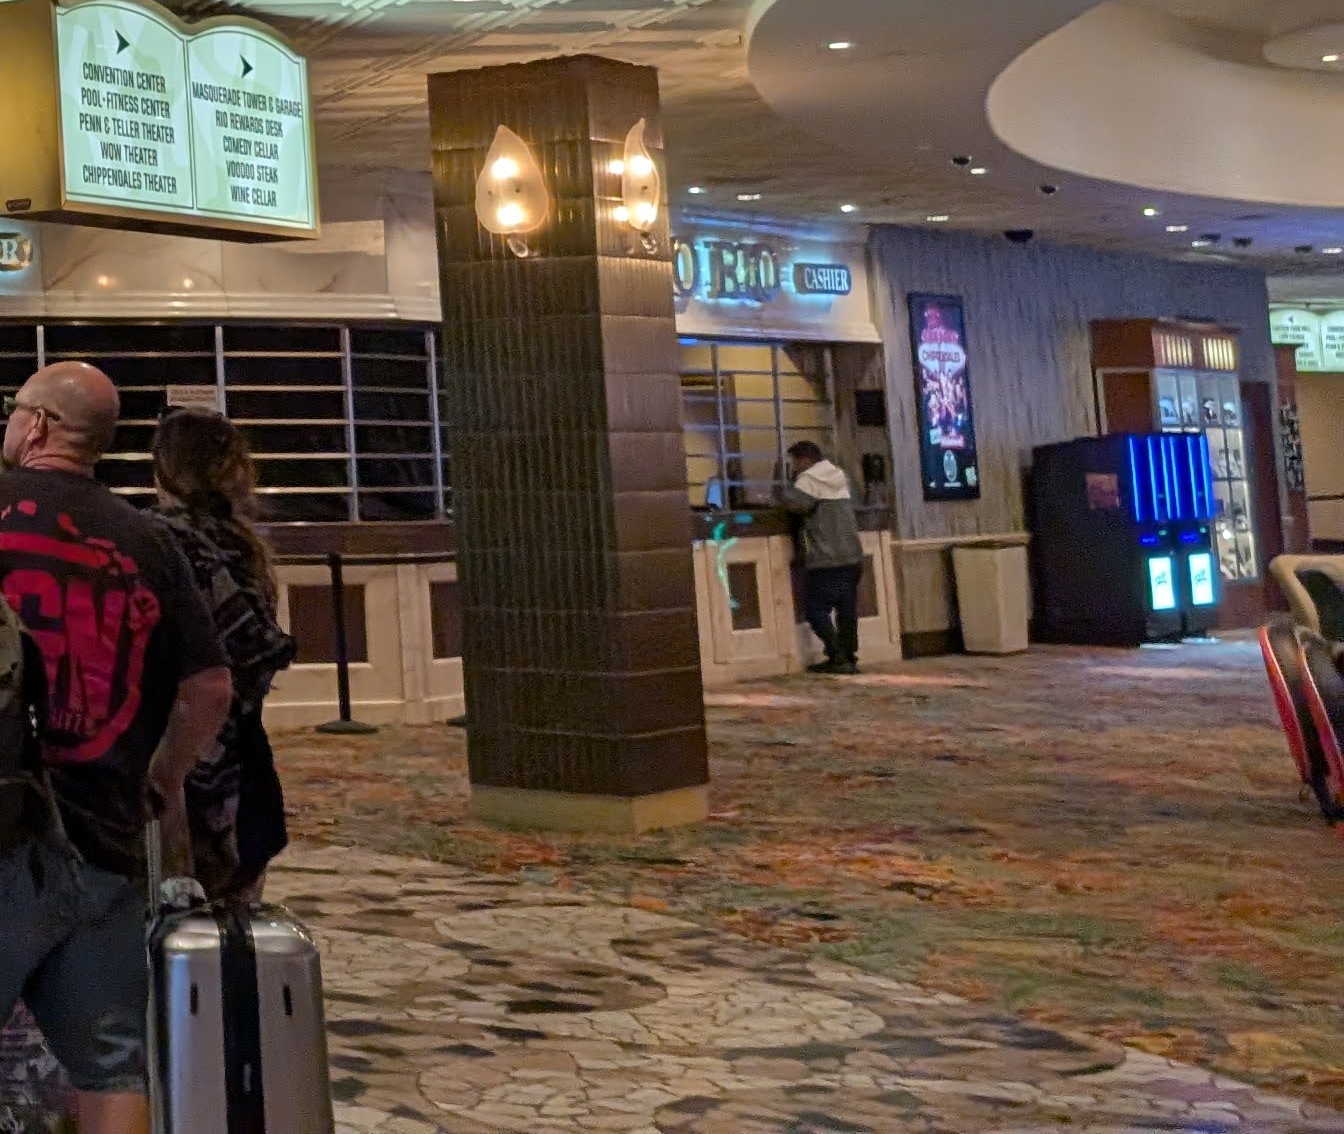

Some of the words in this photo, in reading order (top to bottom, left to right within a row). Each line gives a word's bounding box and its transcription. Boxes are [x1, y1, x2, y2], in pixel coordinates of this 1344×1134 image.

[82, 61, 135, 88] CONVENTION
[136, 71, 166, 94] CENTER
[140, 97, 171, 119] CENTER
[192, 81, 242, 107] MASQUERADE
[242, 90, 267, 112] TOWER
[275, 97, 303, 119] GARAGE
[79, 112, 102, 133] PENN
[104, 116, 110, 135] &
[112, 117, 140, 139] TELLER
[141, 122, 175, 144] THEATER
[215, 109, 228, 128] RIO
[230, 112, 264, 135] REWARDS
[265, 118, 284, 137] DESK
[100, 140, 122, 162] WOW
[123, 144, 158, 167] THEATER
[223, 135, 252, 156] COMEDY
[254, 140, 279, 160] CELLAR
[82, 164, 142, 190] CHIPPENDALES
[143, 172, 178, 195] THEATER
[226, 160, 255, 181] VOODOO
[256, 164, 279, 184] STEAK
[230, 185, 250, 204] WINE
[251, 187, 277, 207] CELLAR
[803, 266, 850, 291] CASHIER
